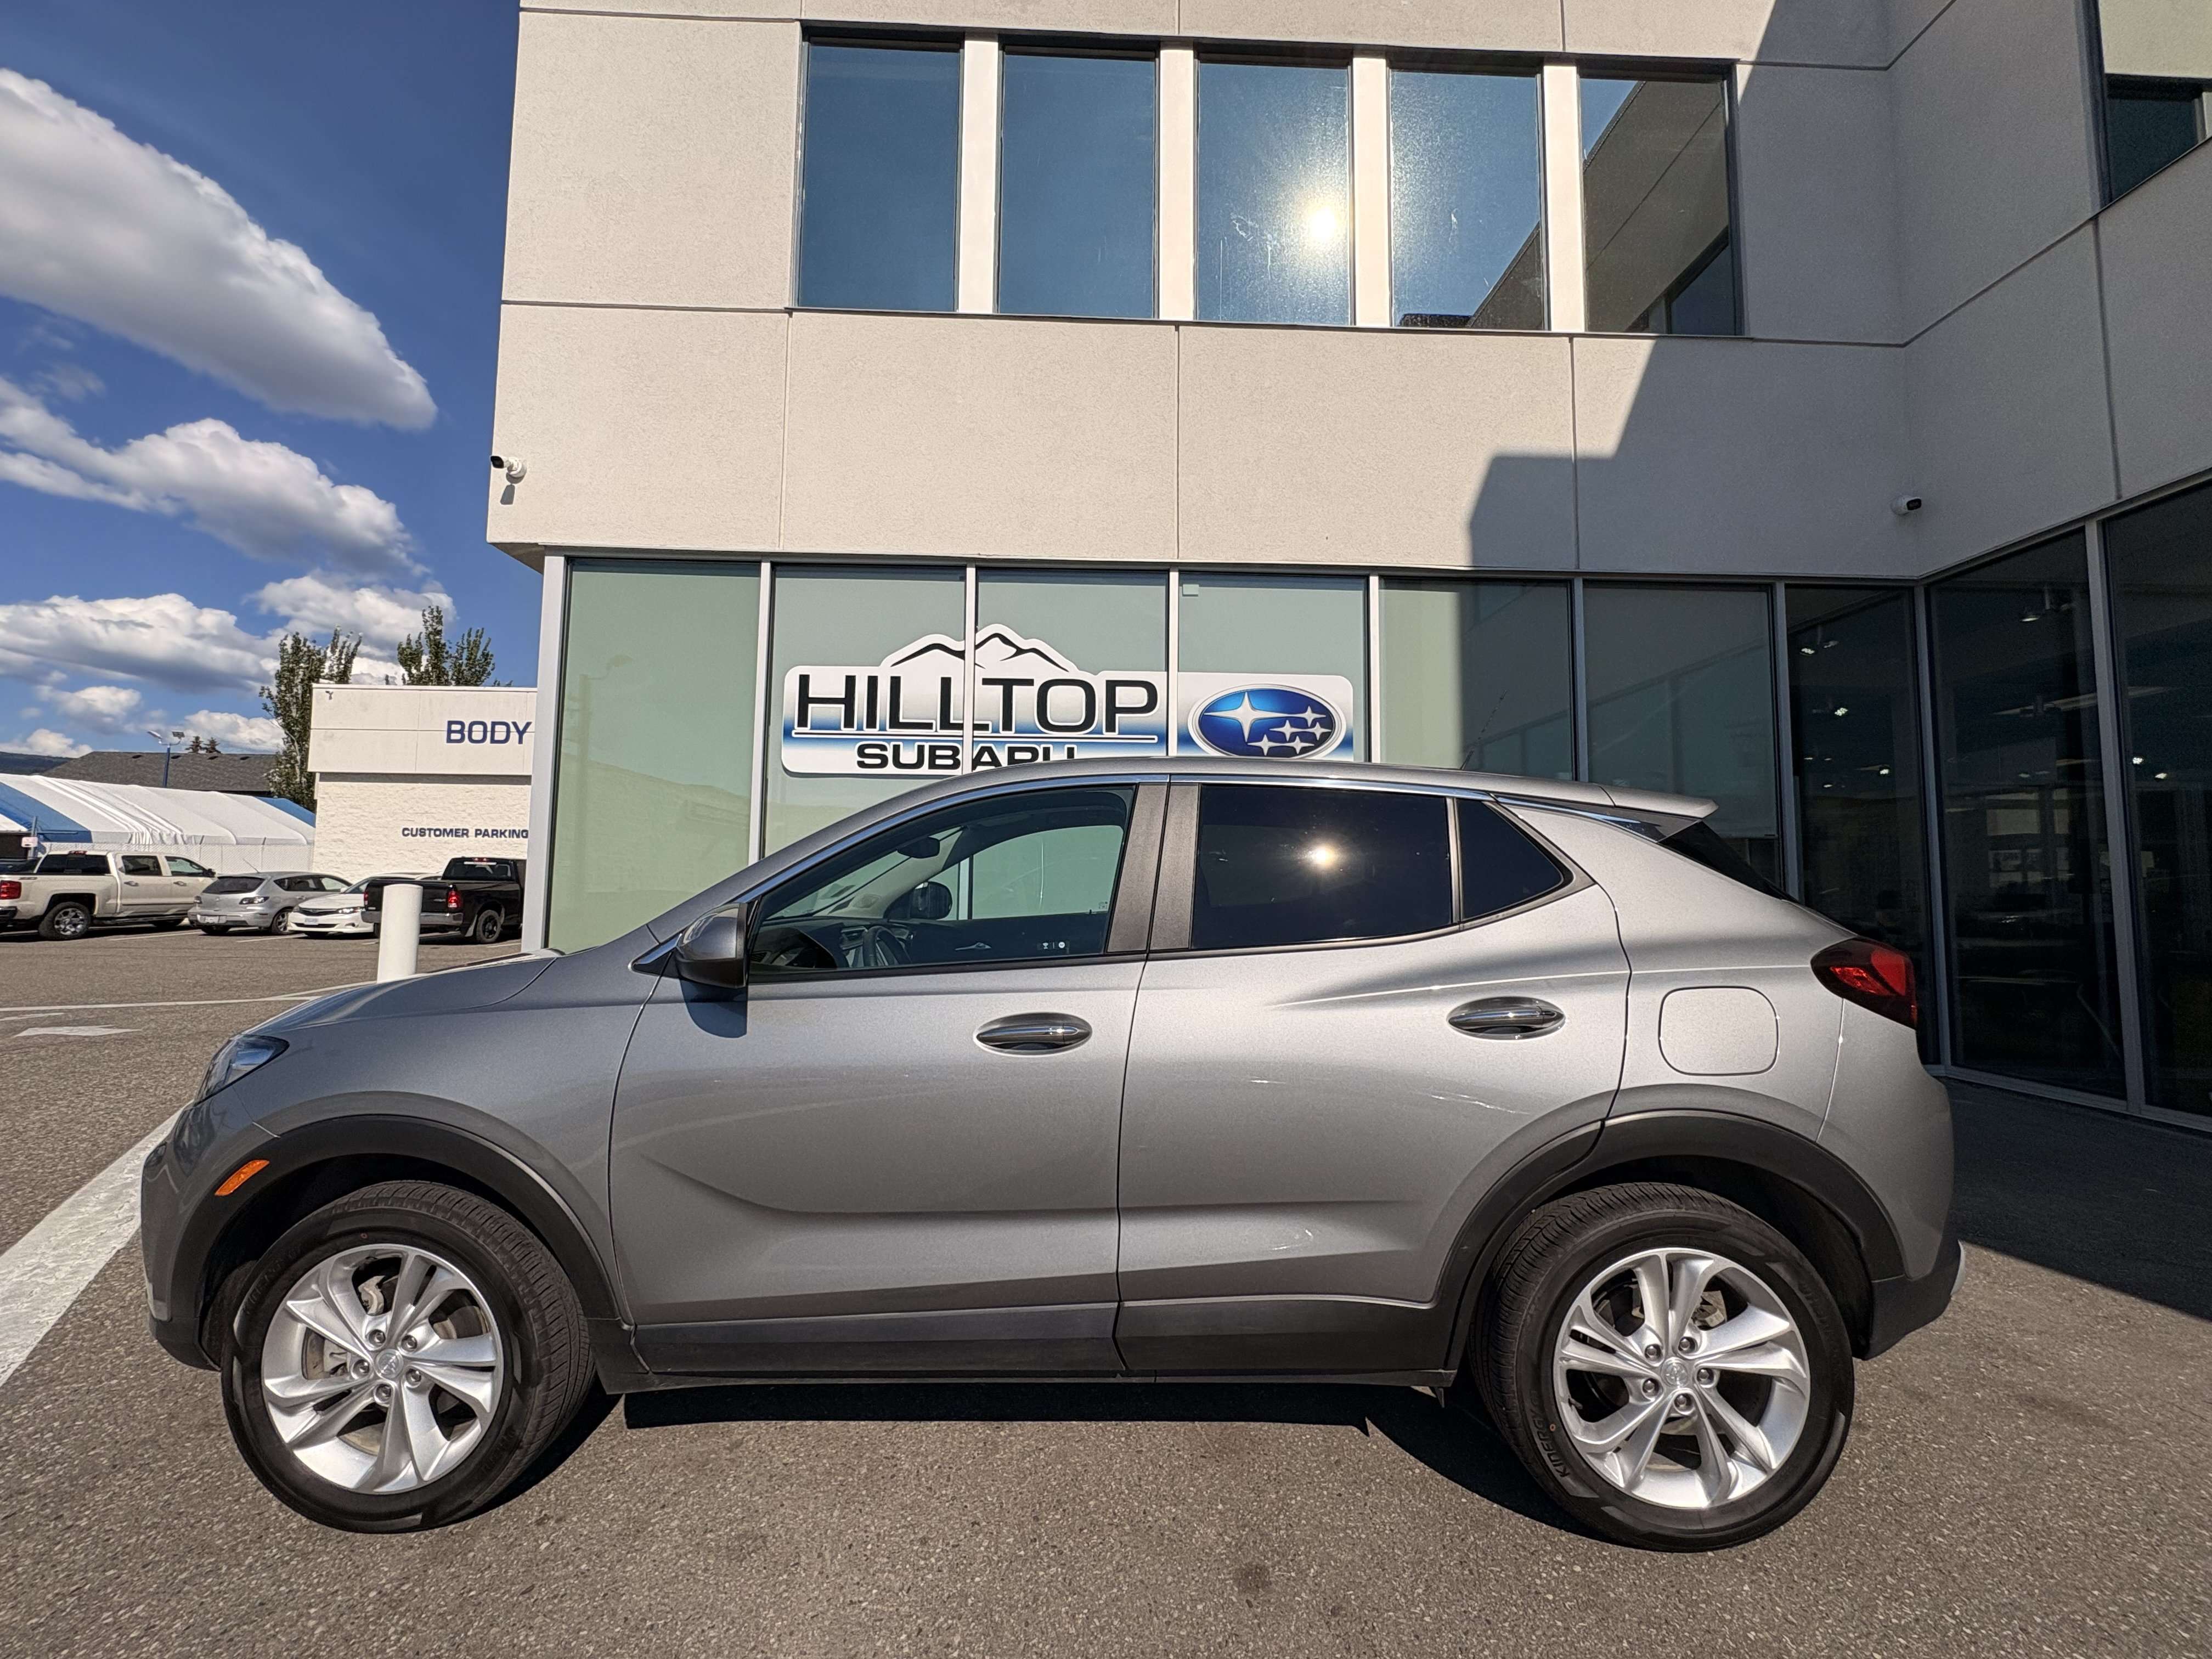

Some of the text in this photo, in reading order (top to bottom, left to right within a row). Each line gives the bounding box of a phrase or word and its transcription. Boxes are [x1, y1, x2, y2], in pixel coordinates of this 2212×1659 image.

[797, 674, 1158, 732] HILLTOP
[446, 720, 532, 744] BODY
[402, 827, 529, 839] CUSTOMER PARKING
[1530, 1408, 1570, 1477] KINERGY
